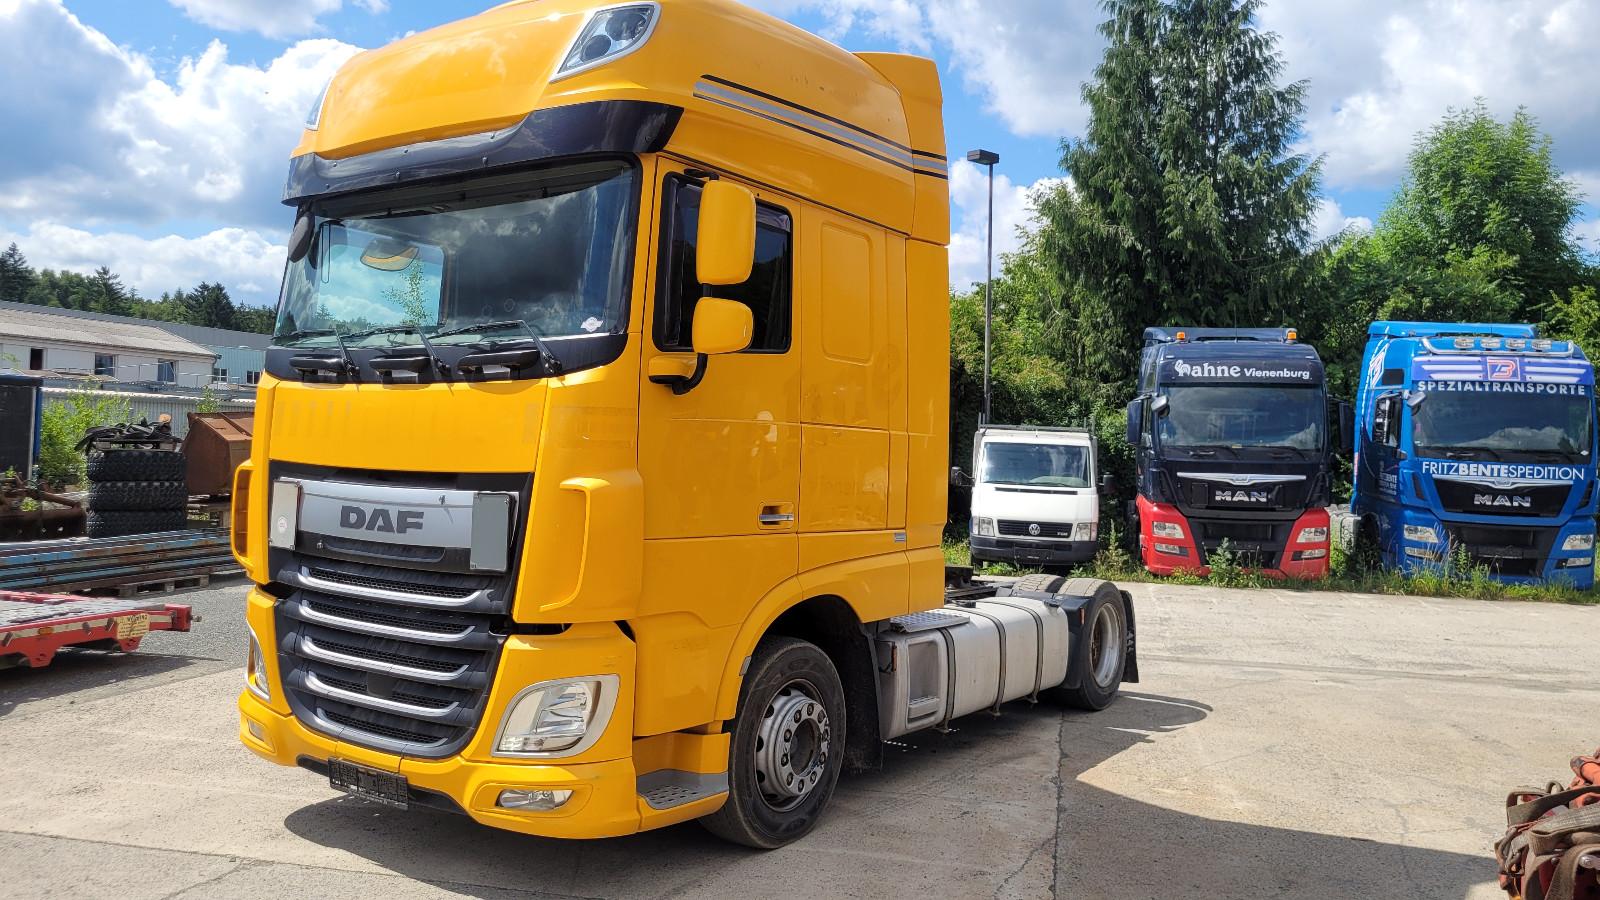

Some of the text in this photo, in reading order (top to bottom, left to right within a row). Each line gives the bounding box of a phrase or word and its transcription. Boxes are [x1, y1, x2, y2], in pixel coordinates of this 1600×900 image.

[1244, 368, 1310, 380] Vienenburg
[1418, 381, 1585, 395] SPEZIALTRANSPORTE
[1215, 490, 1267, 502] MAN
[1474, 494, 1531, 507] MAN
[339, 505, 424, 534] DAF
